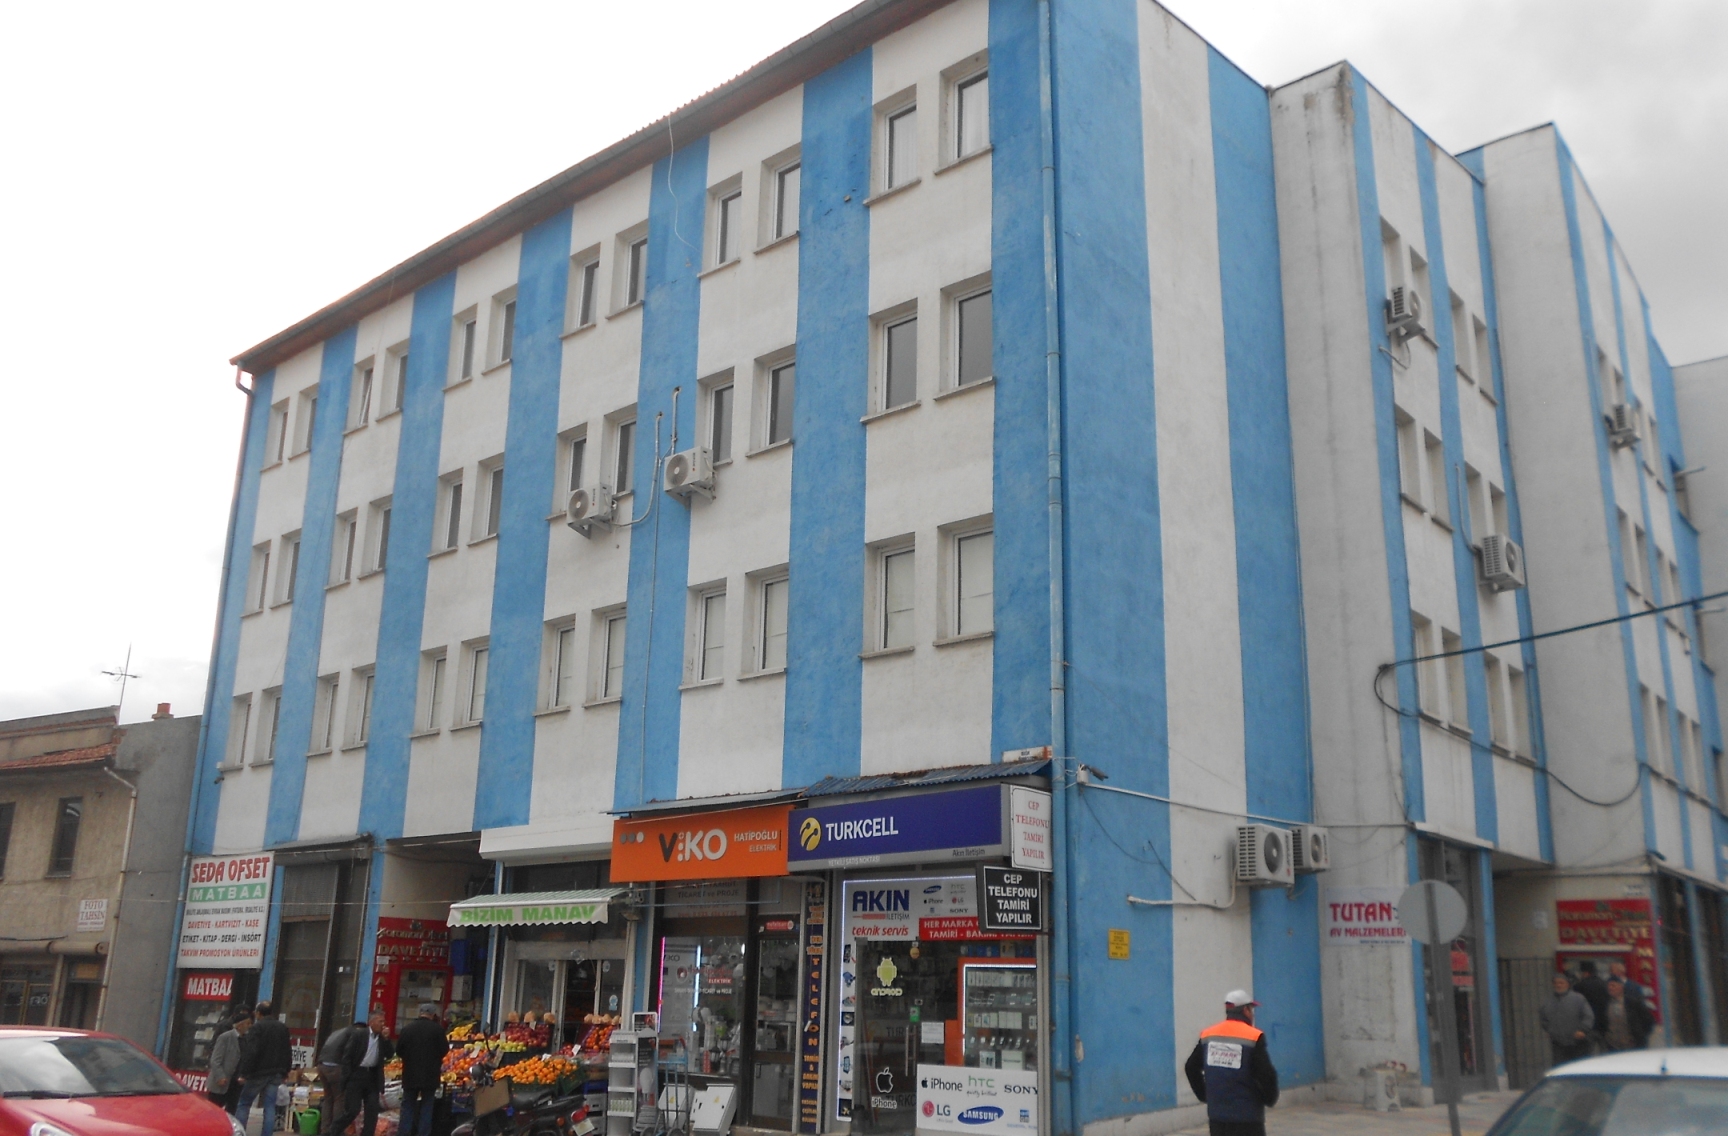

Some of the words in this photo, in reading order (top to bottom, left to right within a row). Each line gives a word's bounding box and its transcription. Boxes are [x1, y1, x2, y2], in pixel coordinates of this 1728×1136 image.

[1028, 800, 1039, 811] CEP
[1015, 815, 1049, 829] TELEFONU
[734, 829, 778, 842] HATİPOĞLU
[826, 816, 898, 842] TURKCELL
[191, 861, 225, 883] SEDA
[228, 857, 270, 882] OFSET
[1004, 874, 1022, 884] CEP
[192, 885, 262, 901] MATBAA
[988, 886, 1038, 898] TELEFONU
[84, 900, 103, 910] FOTO
[852, 889, 910, 912] AKIN
[997, 899, 1030, 911] TAMİRİ
[459, 906, 513, 923] BİZİM
[522, 905, 596, 922] MANAV
[996, 912, 1032, 924] YAPILIR
[852, 925, 880, 936] teknik
[882, 925, 909, 936] servis
[924, 921, 940, 929] HER
[942, 920, 974, 928] MARKA
[929, 929, 958, 939] TAMİRİ
[931, 1078, 963, 1092] iPhone
[1004, 1084, 1038, 1095] SONY
[871, 1096, 897, 1109] iPhone
[936, 1104, 951, 1117] LG
[963, 1110, 998, 1121] SAMSUNG
